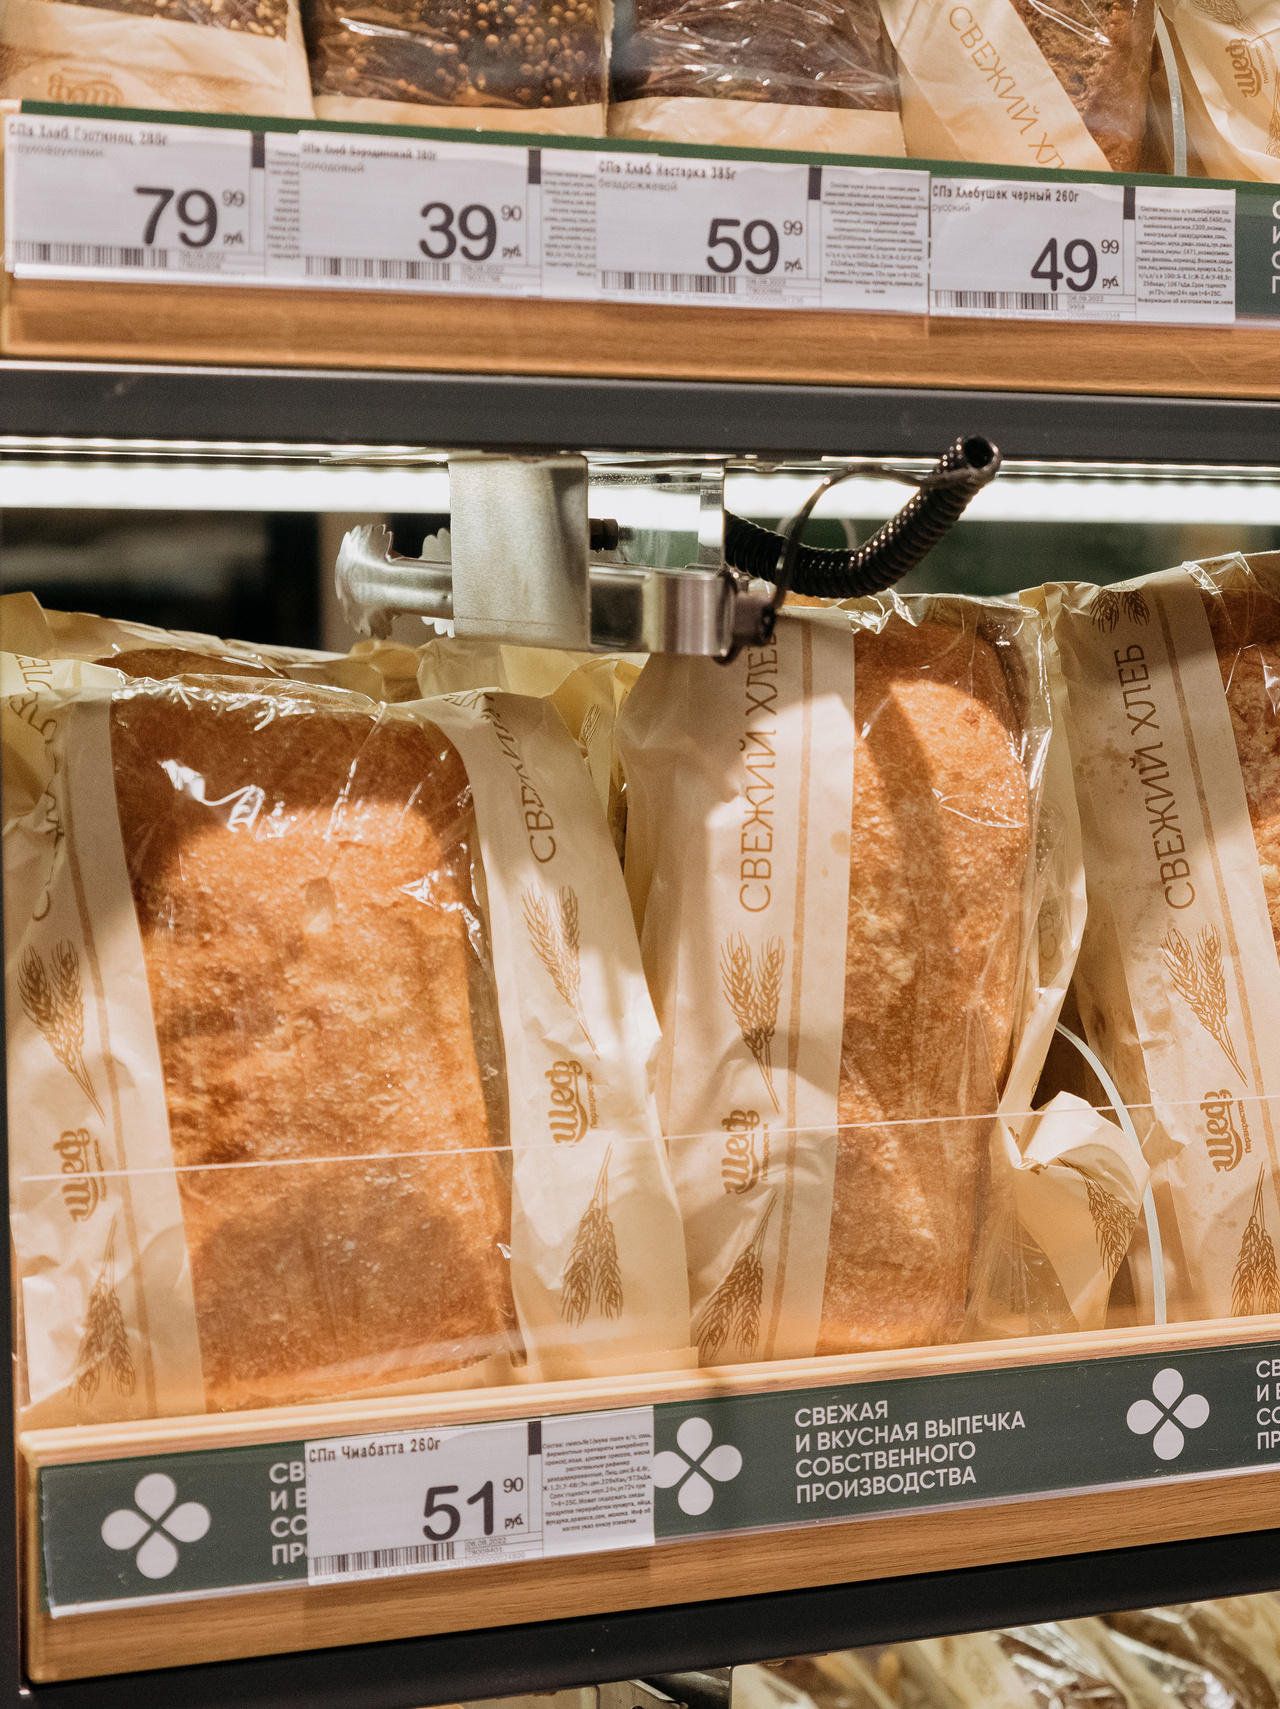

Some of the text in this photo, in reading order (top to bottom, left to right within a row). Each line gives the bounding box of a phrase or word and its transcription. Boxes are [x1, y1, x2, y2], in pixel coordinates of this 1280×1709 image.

[949, 6, 1038, 135] СВЕЖИЙ
[956, 186, 1007, 201] Хлебушек
[1012, 189, 1051, 203] черный
[1055, 190, 1079, 202] 260г
[134, 187, 245, 247] 79 99
[418, 202, 522, 261] 39 90
[707, 218, 803, 275] 59 99
[1030, 237, 1119, 292] 49 99
[1102, 276, 1119, 288] руб.
[739, 632, 778, 912] СВЕЖИЙ ХЛЕ
[1115, 644, 1196, 910] СВЕЖИЙ ХЛЕБ
[1257, 1384, 1269, 1402] И
[794, 1400, 888, 1428] СВЕЖАЯ
[795, 1411, 1026, 1453] И ВКУСНАЯ ВЫПЕЧКА
[310, 1437, 441, 1463] СПп Чиабатта 260г
[795, 1441, 976, 1478] СОБСТВЕННОГО
[270, 1489, 288, 1512] И
[796, 1465, 977, 1504] ПРОИЗВОДСТВА
[422, 1477, 524, 1542] 51 90
[504, 1514, 524, 1529] руб.
[272, 1542, 308, 1566] ПР
